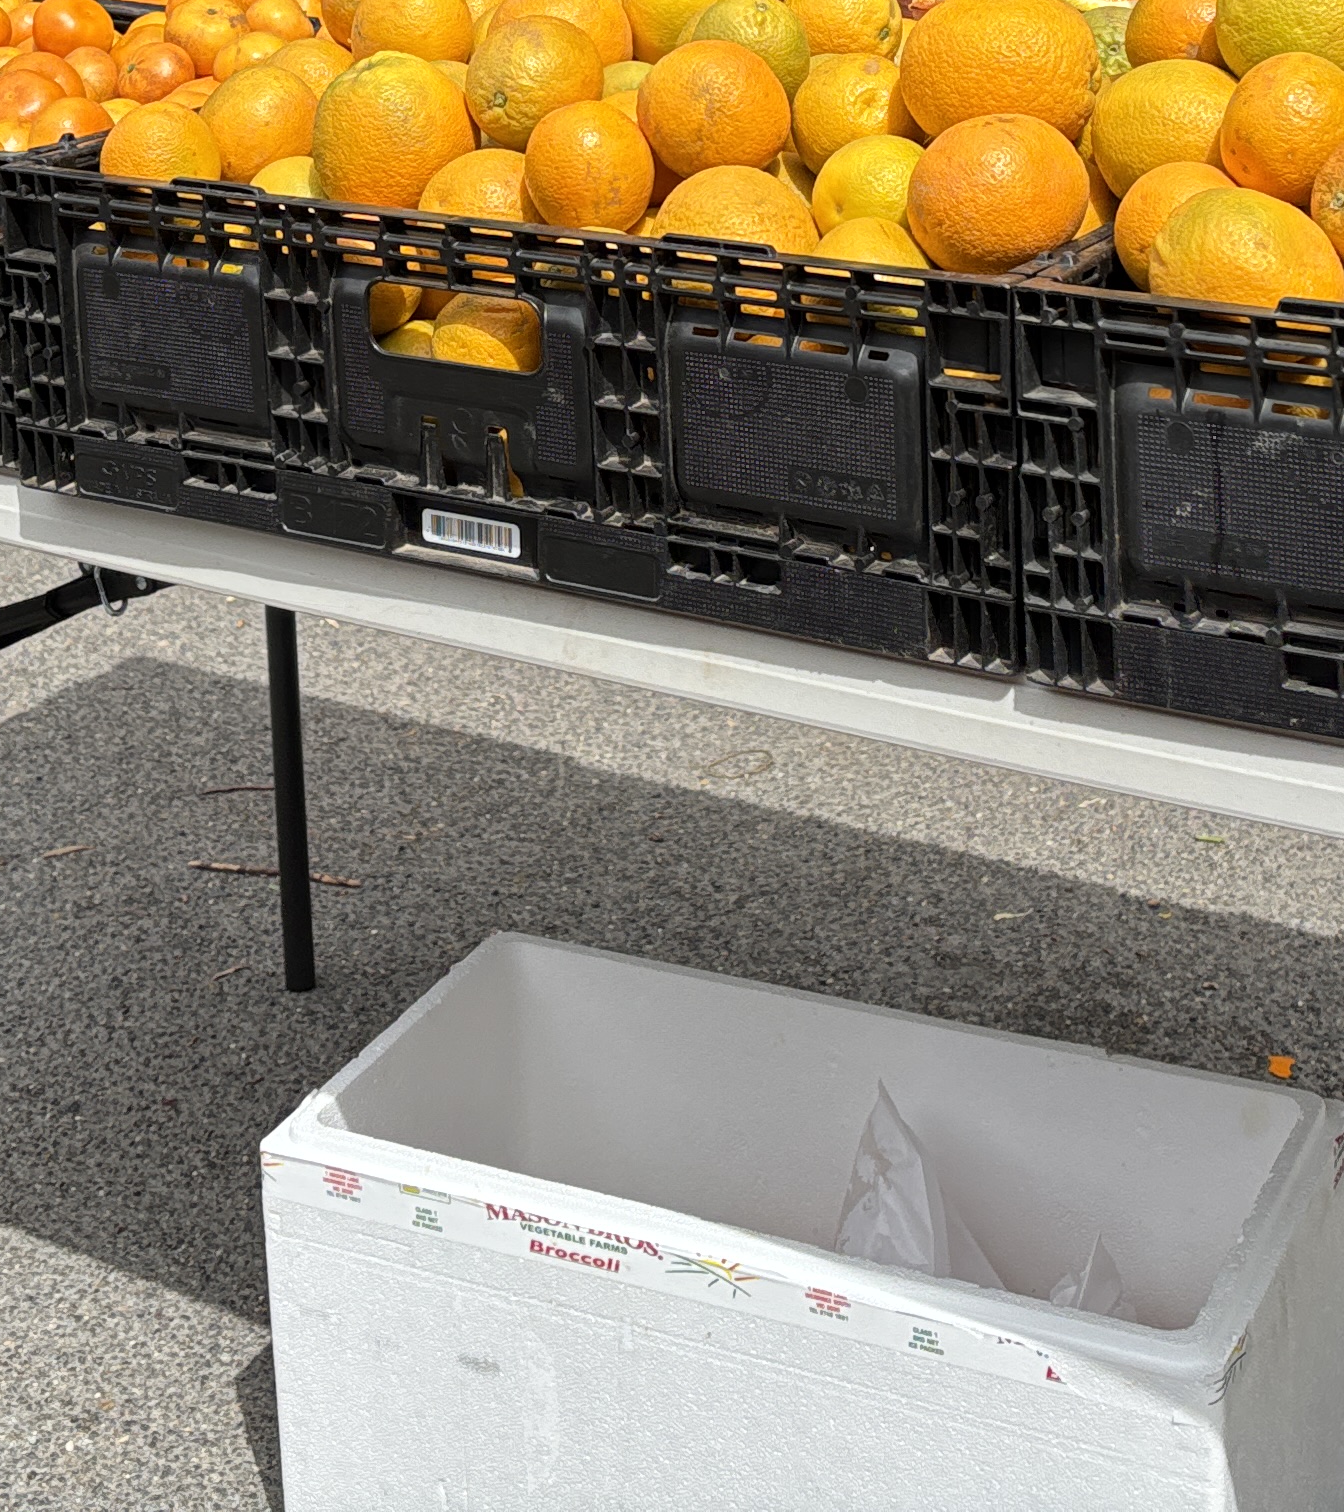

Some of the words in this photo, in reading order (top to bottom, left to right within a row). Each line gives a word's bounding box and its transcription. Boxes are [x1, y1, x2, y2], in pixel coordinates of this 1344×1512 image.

[519, 1221, 587, 1246] VEGETABLE
[589, 1238, 629, 1256] FARMS
[529, 1238, 621, 1273] Broccoli
